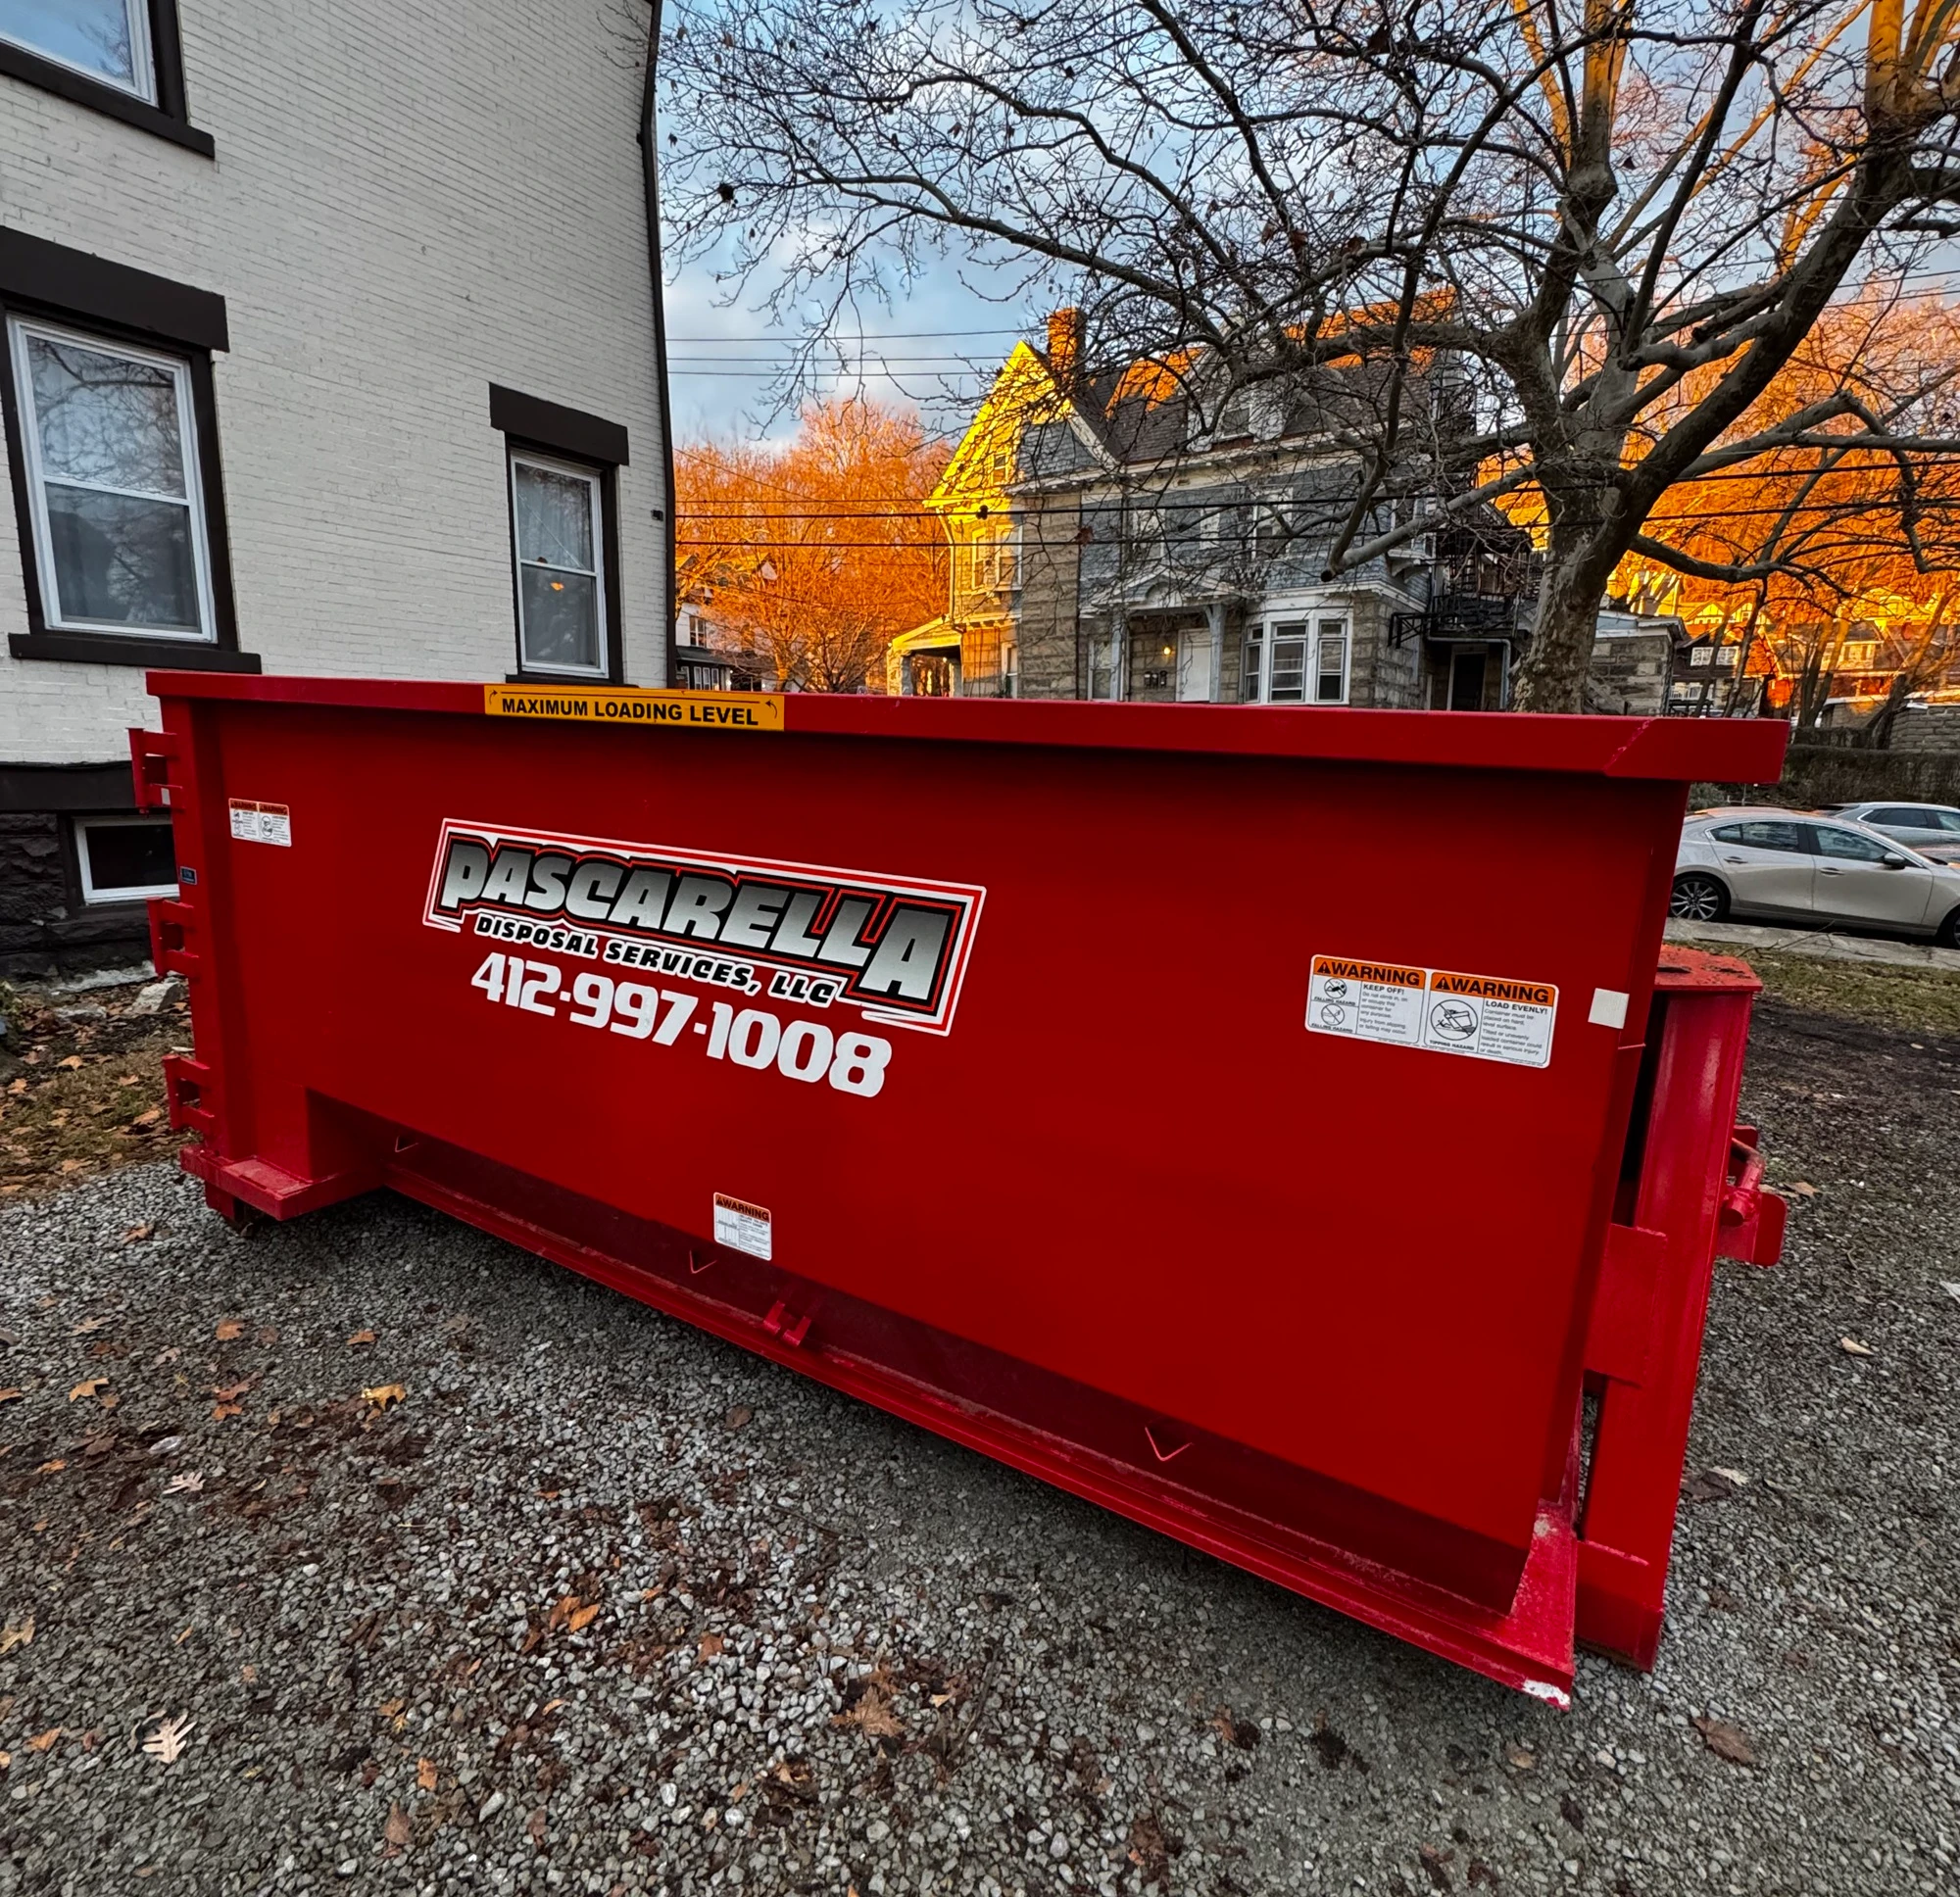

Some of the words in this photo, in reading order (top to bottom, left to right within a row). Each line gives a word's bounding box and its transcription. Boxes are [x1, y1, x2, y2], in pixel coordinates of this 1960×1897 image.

[502, 698, 588, 716] MAXIMUM
[594, 701, 683, 721] LOADING
[689, 705, 760, 726] LEVEL
[440, 843, 950, 1000] PASCARELLA
[476, 915, 596, 956] DISPOSAL
[606, 942, 760, 994] SERVICES,
[770, 974, 838, 1006] LLC
[1331, 961, 1420, 987] WARNING
[1450, 977, 1548, 1003] WARNING
[1486, 1000, 1509, 1009] LOAD
[1511, 1003, 1548, 1014] EVENLY!
[722, 1198, 769, 1221] WARNING
